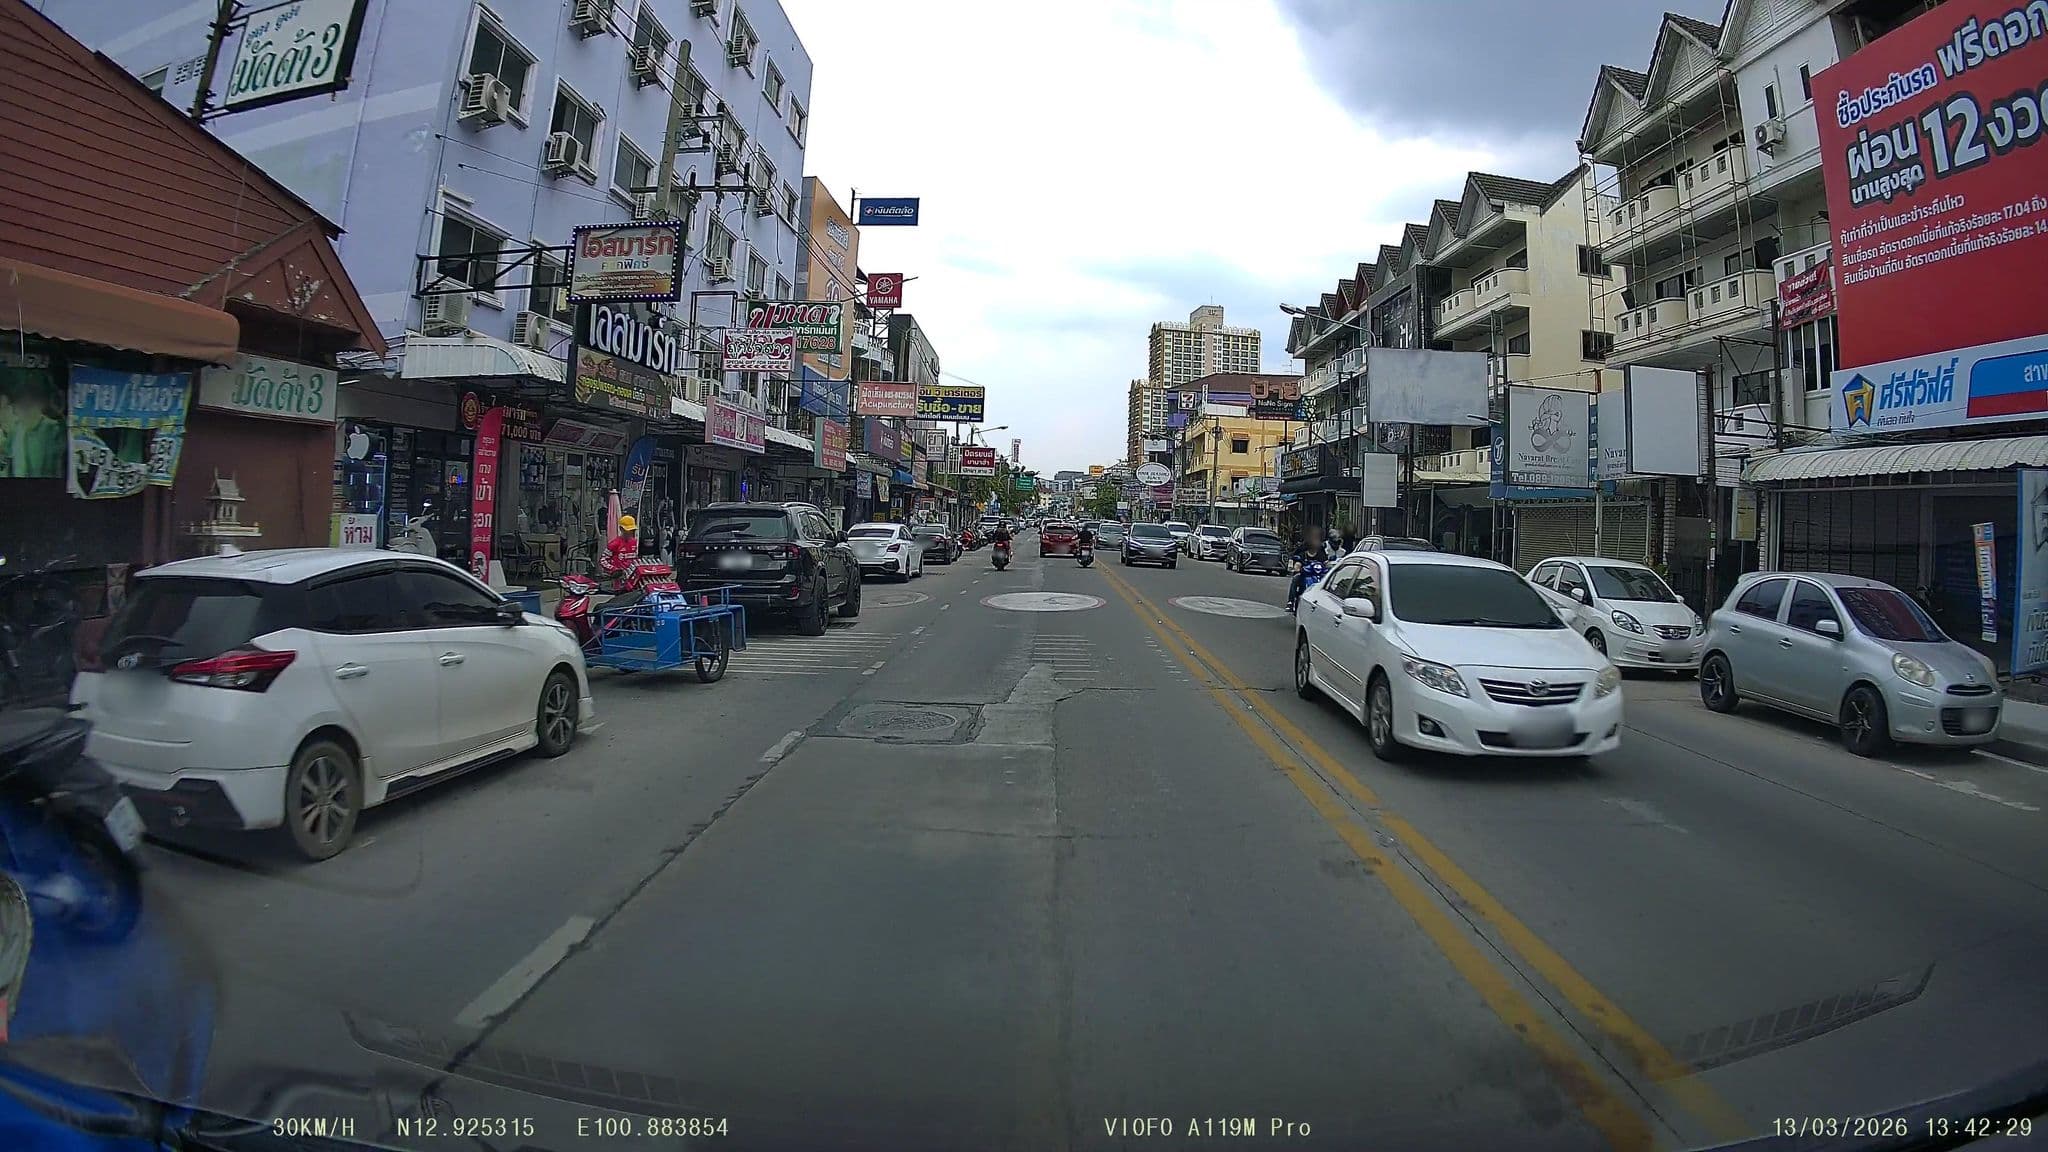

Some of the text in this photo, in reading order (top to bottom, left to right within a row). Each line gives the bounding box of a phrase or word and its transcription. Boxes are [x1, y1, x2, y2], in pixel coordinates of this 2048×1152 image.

[1848, 122, 1919, 180] ผ่อน
[1920, 97, 1986, 173] 12
[2003, 200, 2031, 220] 17.04
[869, 296, 898, 305] YAMAHA
[859, 398, 915, 412] Acupuncture
[958, 403, 982, 414] ขาย
